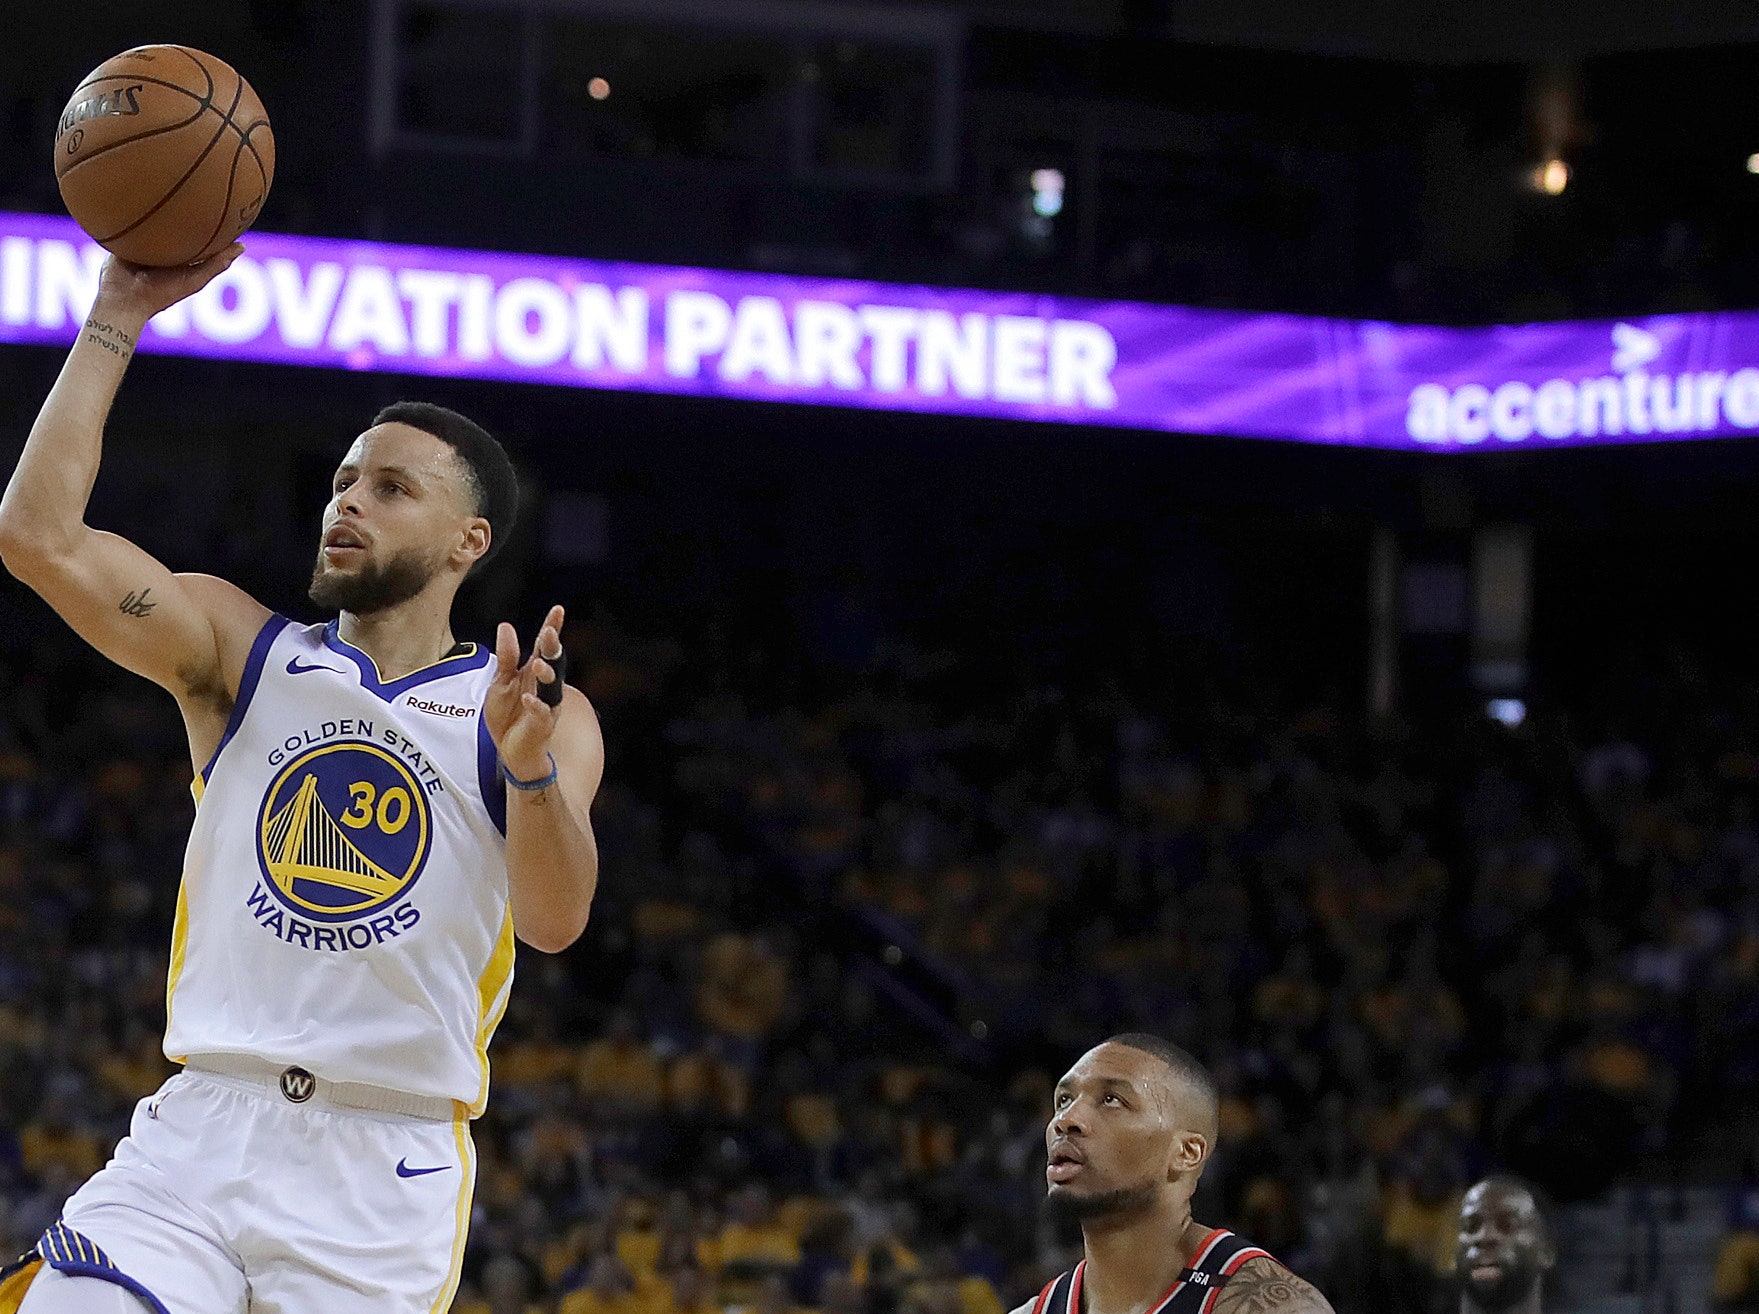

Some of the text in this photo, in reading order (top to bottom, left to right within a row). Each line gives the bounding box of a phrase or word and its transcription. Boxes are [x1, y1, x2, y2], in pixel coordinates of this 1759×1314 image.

[663, 294, 1119, 410] PARTNER
[406, 696, 476, 718] Rakuten
[267, 719, 444, 796] GOLDEN STATE
[341, 781, 411, 835] 30
[245, 880, 421, 952] WARRIORS
